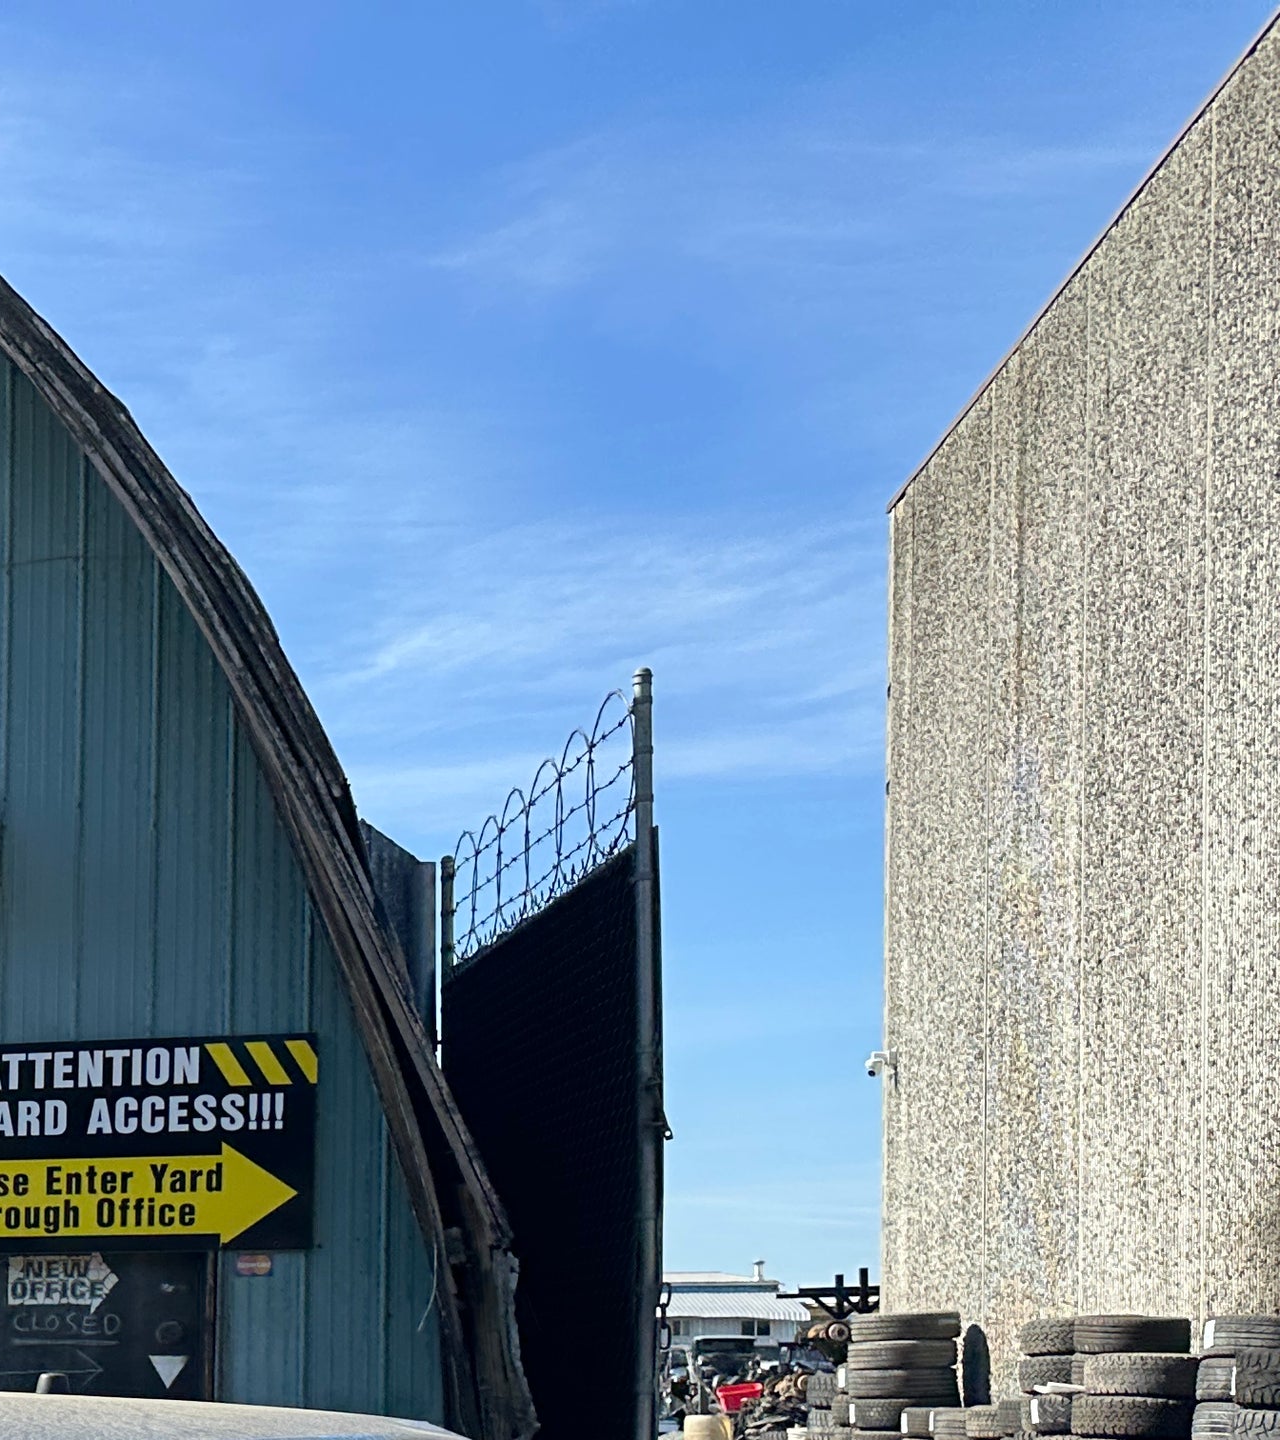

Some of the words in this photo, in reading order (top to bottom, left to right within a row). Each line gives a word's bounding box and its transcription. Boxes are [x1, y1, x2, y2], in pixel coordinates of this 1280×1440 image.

[86, 1091, 285, 1135] ACCESS!!!
[45, 1165, 134, 1196] Enter
[149, 1162, 224, 1194] Yard
[96, 1198, 197, 1229] Office
[22, 1257, 86, 1279] NEW
[10, 1278, 106, 1301] OFFICE
[14, 1312, 121, 1335] CLOSED
